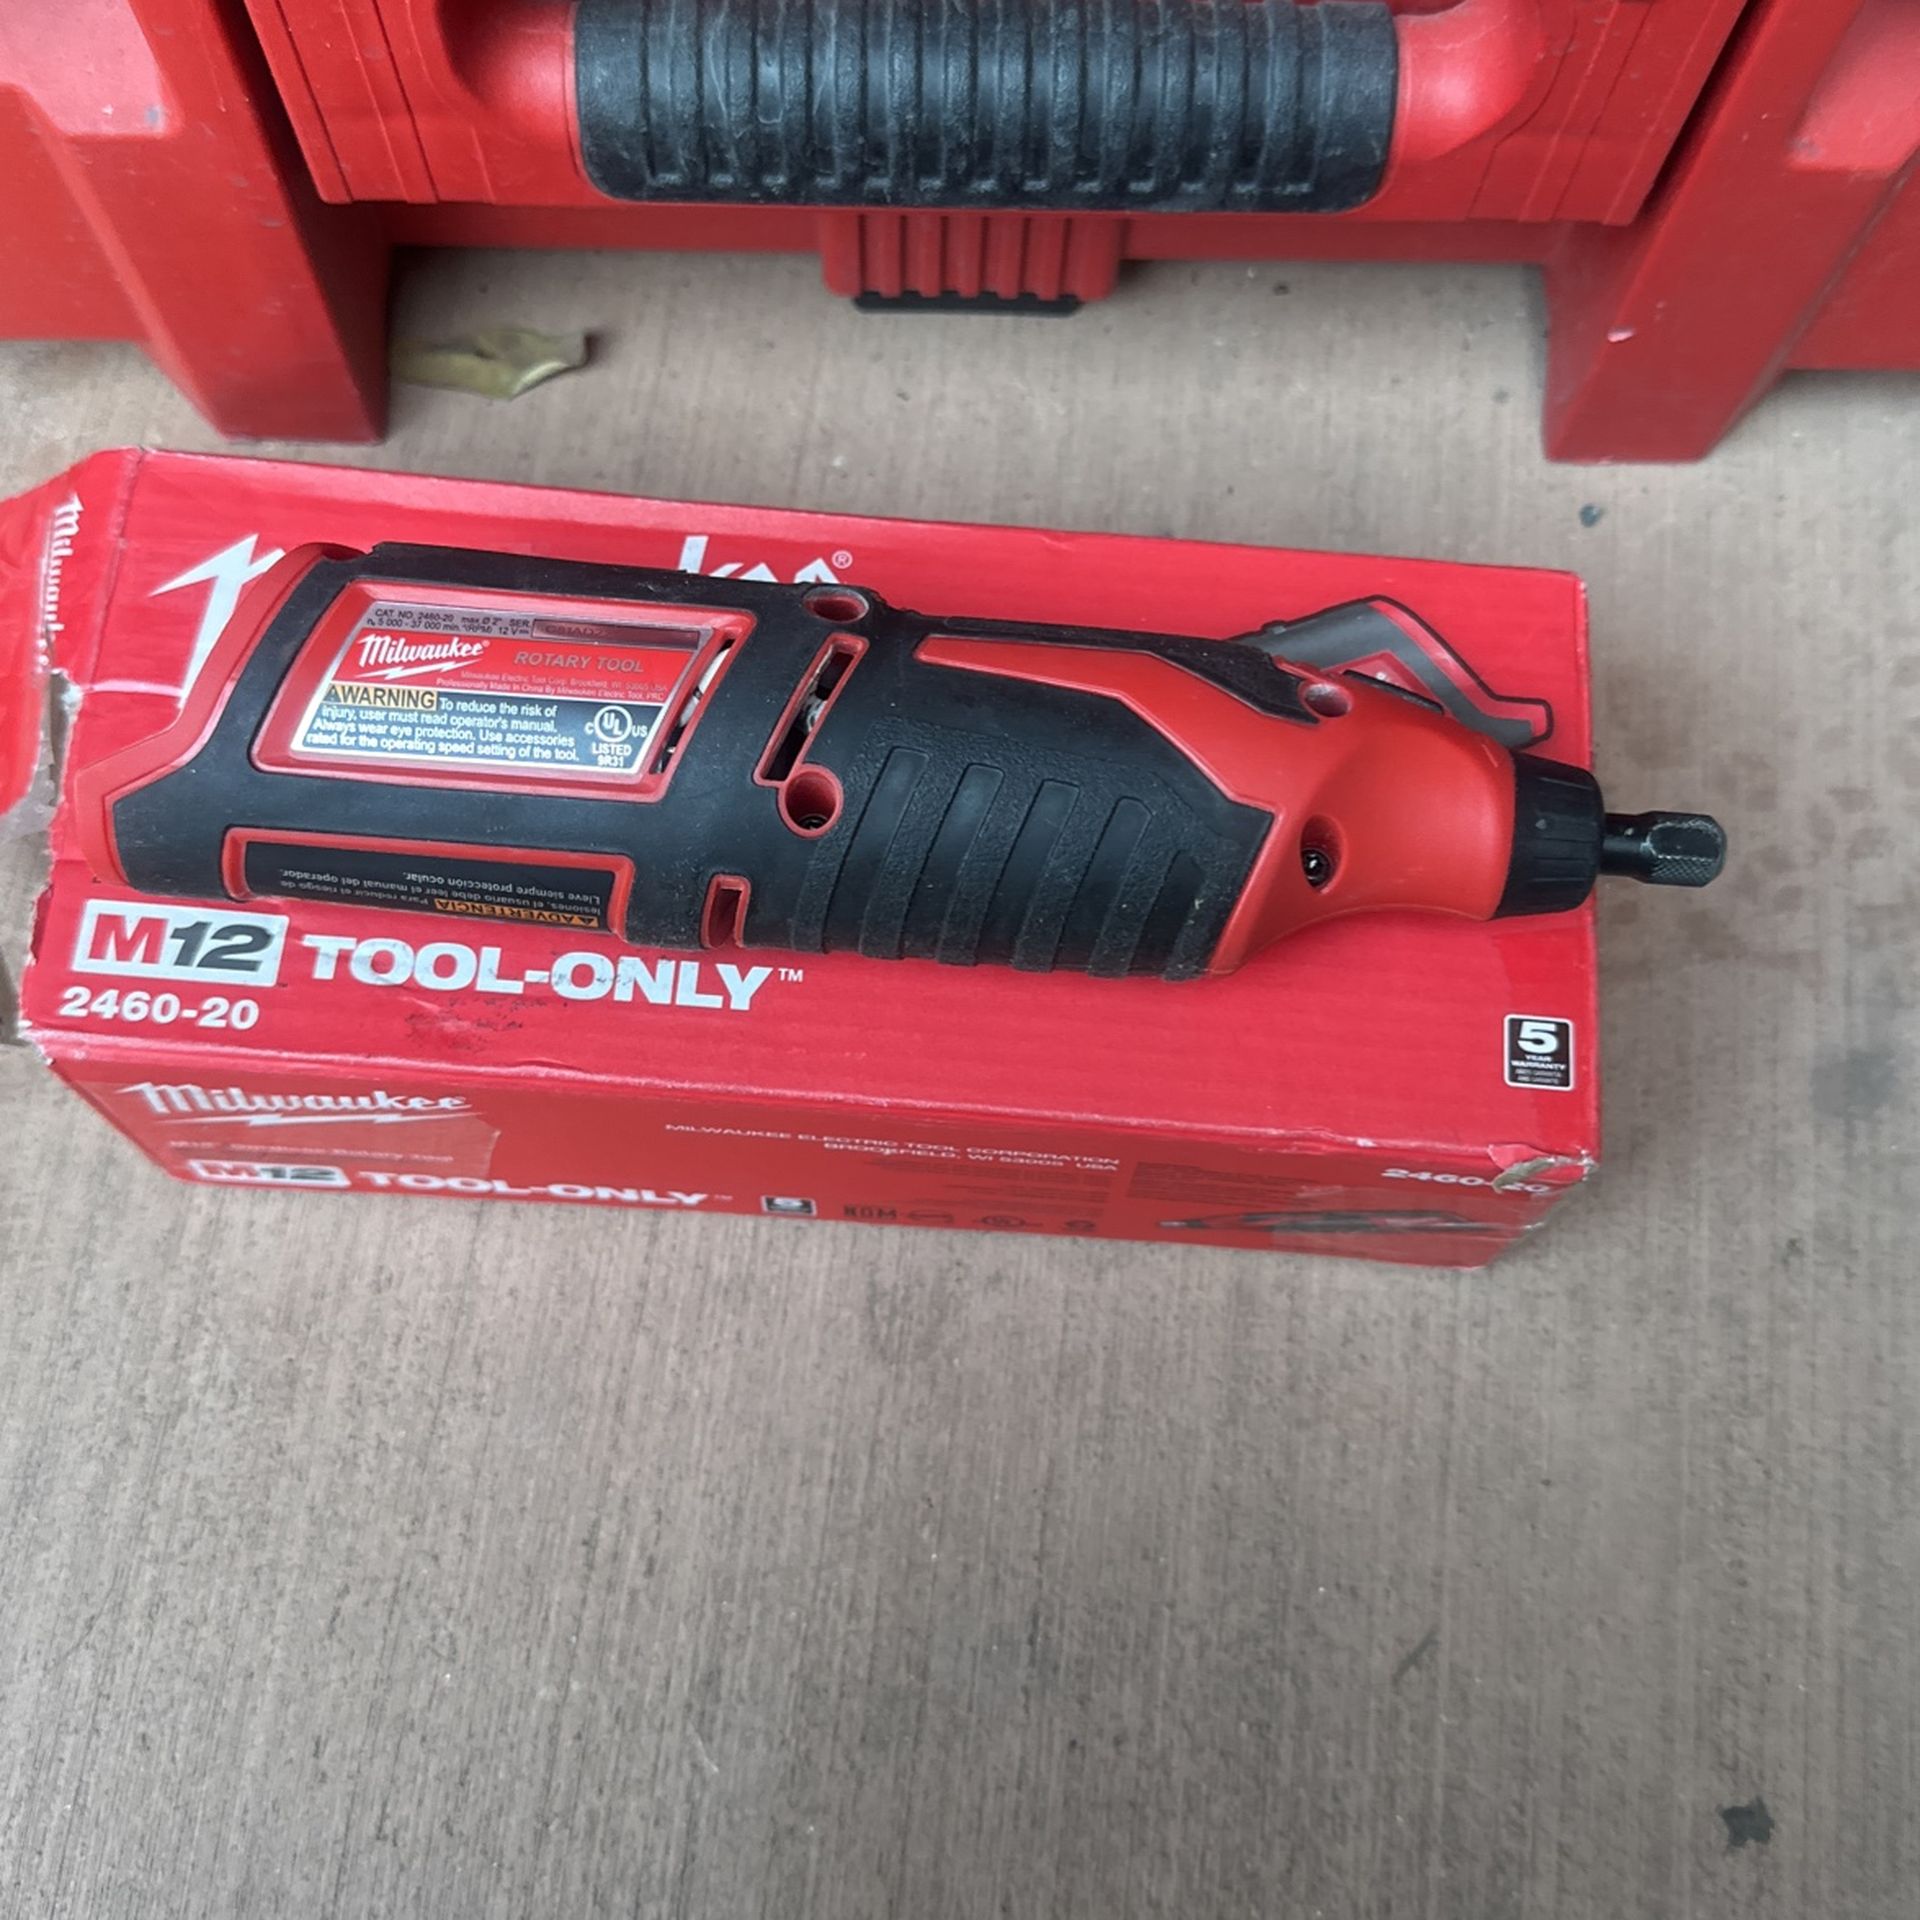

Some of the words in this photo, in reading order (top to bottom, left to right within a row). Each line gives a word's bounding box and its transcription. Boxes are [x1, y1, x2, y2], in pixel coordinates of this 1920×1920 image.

[514, 651, 591, 669] ROTARY
[598, 656, 645, 673] TOOL
[341, 685, 436, 709] WARNING
[440, 697, 454, 711] To
[456, 700, 497, 714] reduce
[499, 702, 519, 715] the
[521, 703, 542, 717] risk
[544, 704, 558, 718] of
[322, 705, 357, 721] injury,
[359, 709, 387, 721] user
[388, 710, 419, 723] must
[420, 711, 447, 725] read
[450, 715, 509, 731] operator's
[511, 719, 558, 733] manual.
[313, 717, 356, 735] Always
[358, 723, 388, 735] wear
[390, 725, 412, 739] eye
[415, 725, 476, 743] protection.
[480, 729, 503, 742] Use
[505, 732, 575, 747] accessories
[632, 724, 648, 738] US
[306, 731, 338, 745] rated
[340, 733, 357, 746] for
[360, 735, 378, 747] the
[380, 737, 436, 754] operating
[438, 741, 475, 755] speed
[477, 743, 517, 760] setting
[518, 745, 531, 758] of
[533, 746, 552, 760] the
[555, 748, 580, 761] tool.
[591, 742, 632, 756] LISTED
[280, 869, 339, 884] operador.
[341, 876, 360, 887] del
[403, 871, 445, 885] ocular.
[363, 879, 408, 892] manual
[411, 884, 422, 894] el
[427, 886, 448, 897] leer
[447, 877, 513, 894] protección
[516, 885, 565, 899] siempre
[451, 889, 481, 900] debe
[485, 894, 531, 907] usuario
[568, 892, 600, 905] Lleve
[534, 899, 545, 909] el
[437, 900, 574, 925] ADVERTENCIA
[89, 913, 274, 972] M12
[302, 934, 773, 1011] TOOL-ONLY
[58, 985, 260, 1030] 2460-20
[1517, 1021, 1558, 1055] 5
[1510, 1060, 1567, 1071] WARRANTY
[115, 1082, 472, 1114] Milwaukee
[665, 1123, 792, 1139] MILWAUKEE
[797, 1133, 899, 1147] ELECTRIC
[904, 1141, 961, 1153] TOOL
[966, 1146, 1120, 1165] CORPORATION
[357, 1171, 708, 1206] TOOL-ONLY
